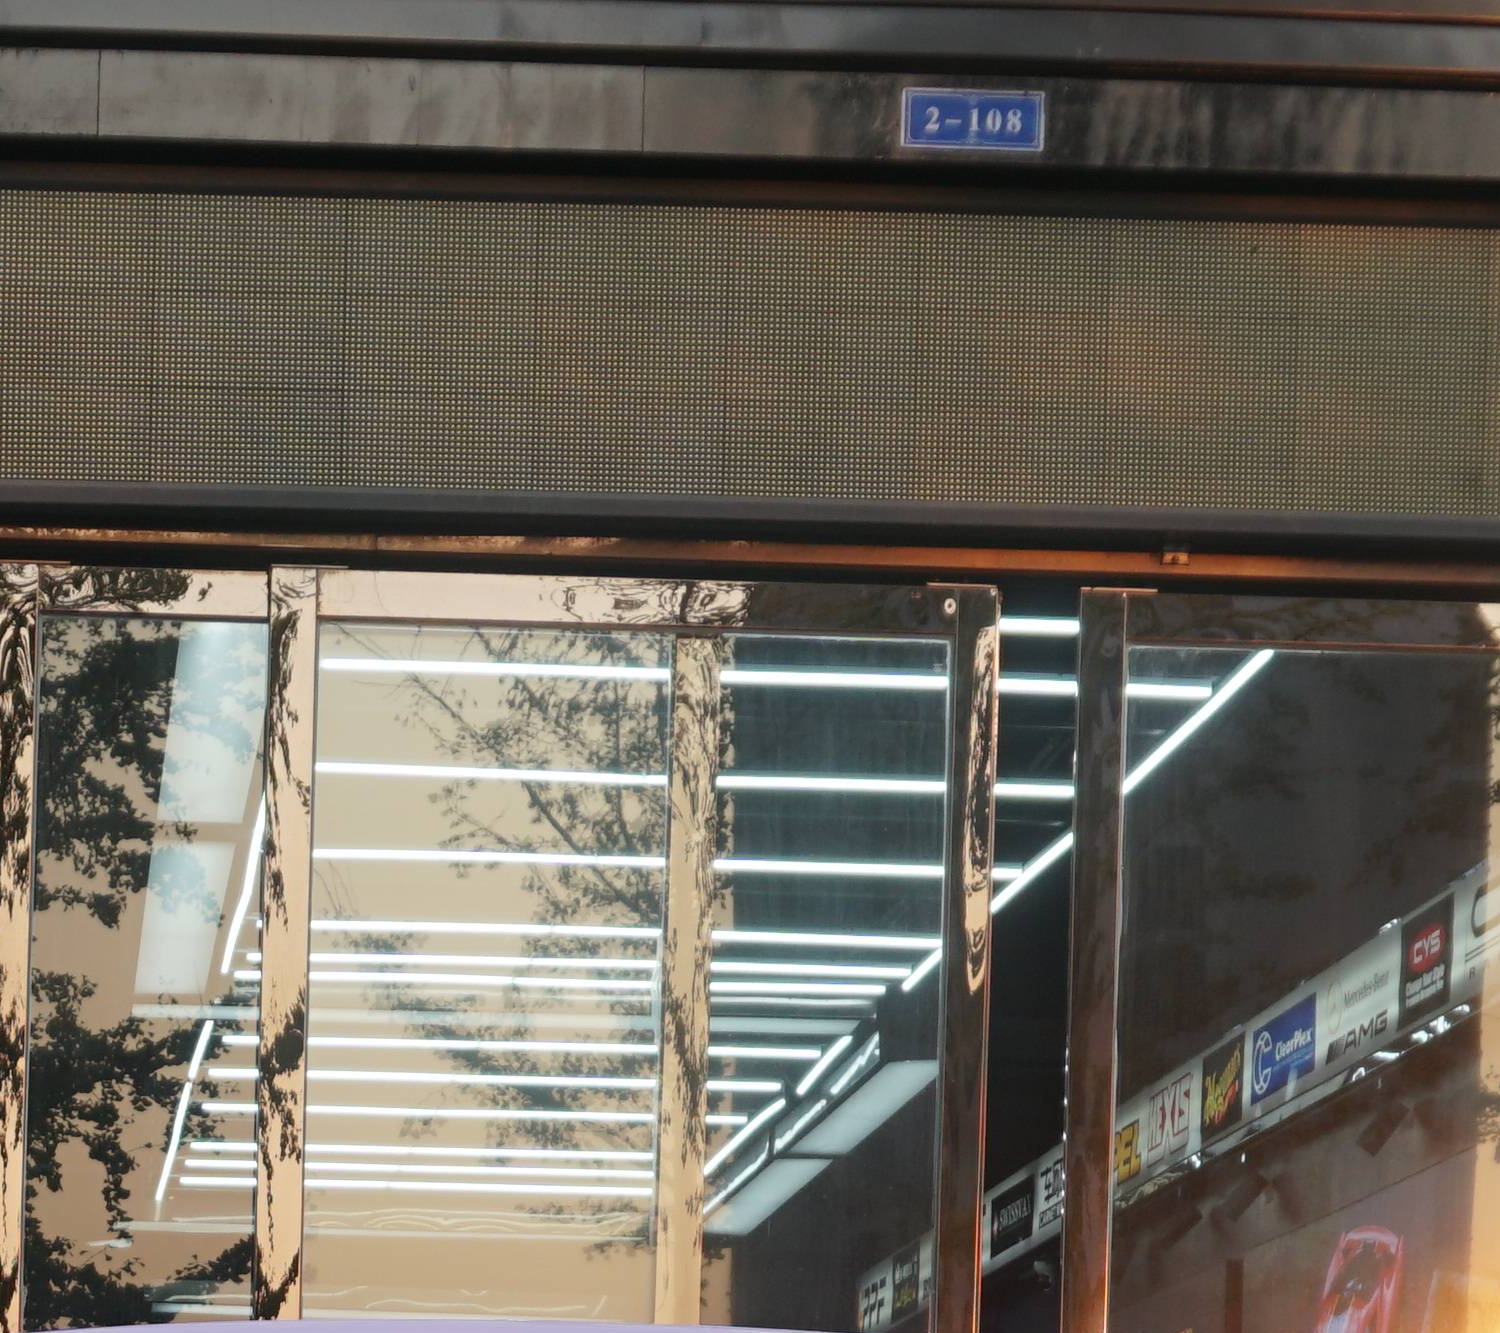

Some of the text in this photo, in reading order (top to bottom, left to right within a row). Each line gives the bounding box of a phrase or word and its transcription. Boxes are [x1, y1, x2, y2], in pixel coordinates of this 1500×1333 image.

[924, 106, 1023, 132] 2-108
[1412, 929, 1442, 964] CYS
[1275, 1027, 1313, 1062] ClearPlex
[1344, 1009, 1388, 1054] AMG
